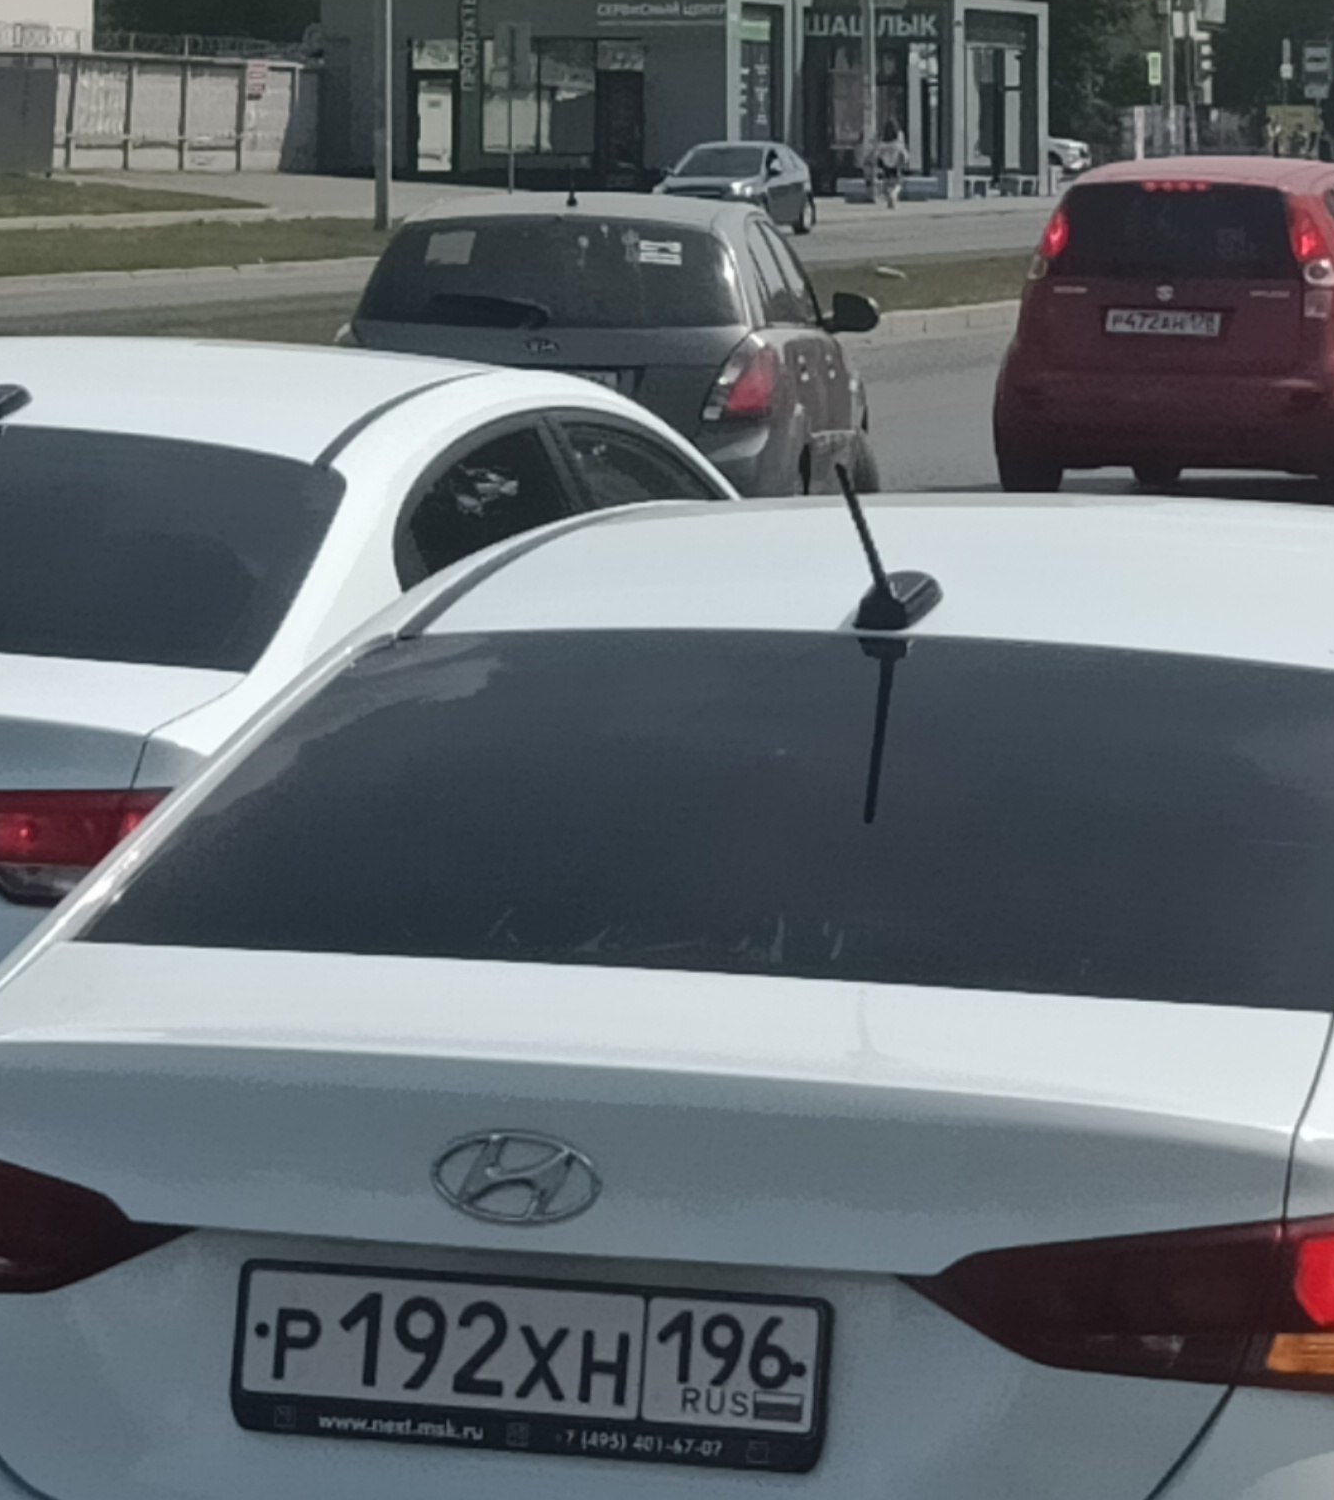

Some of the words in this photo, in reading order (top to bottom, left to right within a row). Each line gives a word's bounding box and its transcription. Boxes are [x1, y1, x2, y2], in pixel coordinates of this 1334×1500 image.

[596, 0, 680, 17] СЕРВИСНЫЙ
[805, 14, 939, 37] ШАШЛЫК
[272, 1293, 631, 1407] Р192ХН
[657, 1310, 791, 1390] 196
[680, 1386, 750, 1417] RUS
[318, 1415, 484, 1440] www.next.msk.ru
[581, 1430, 628, 1451] (495)
